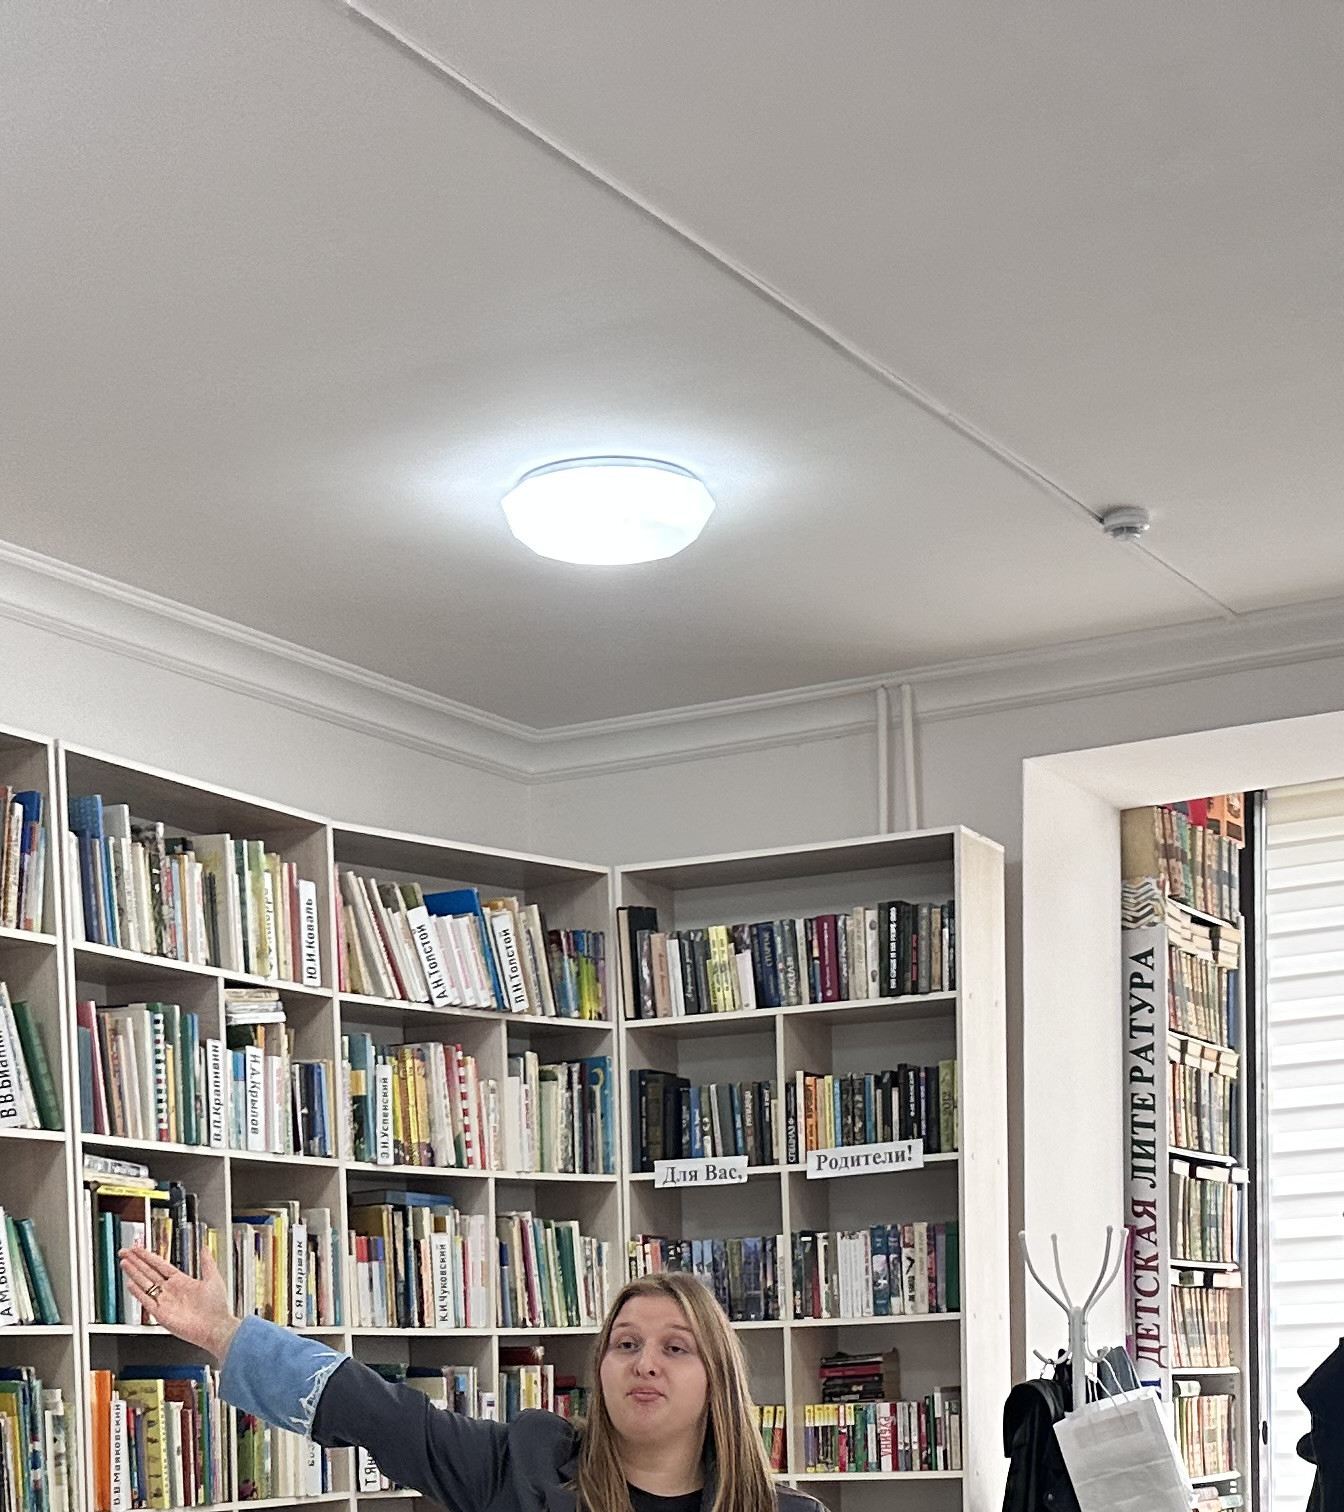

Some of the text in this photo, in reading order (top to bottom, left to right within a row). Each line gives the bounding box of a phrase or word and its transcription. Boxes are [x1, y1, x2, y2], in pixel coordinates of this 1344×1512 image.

[410, 923, 450, 1001] А.Н.Толстой
[1128, 945, 1157, 1190] ЛИТЕРАТУРА
[663, 1165, 743, 1185] Для Вас,
[816, 1145, 913, 1172] Родители!
[1132, 1197, 1168, 1367] ДЕТСКАЯ
